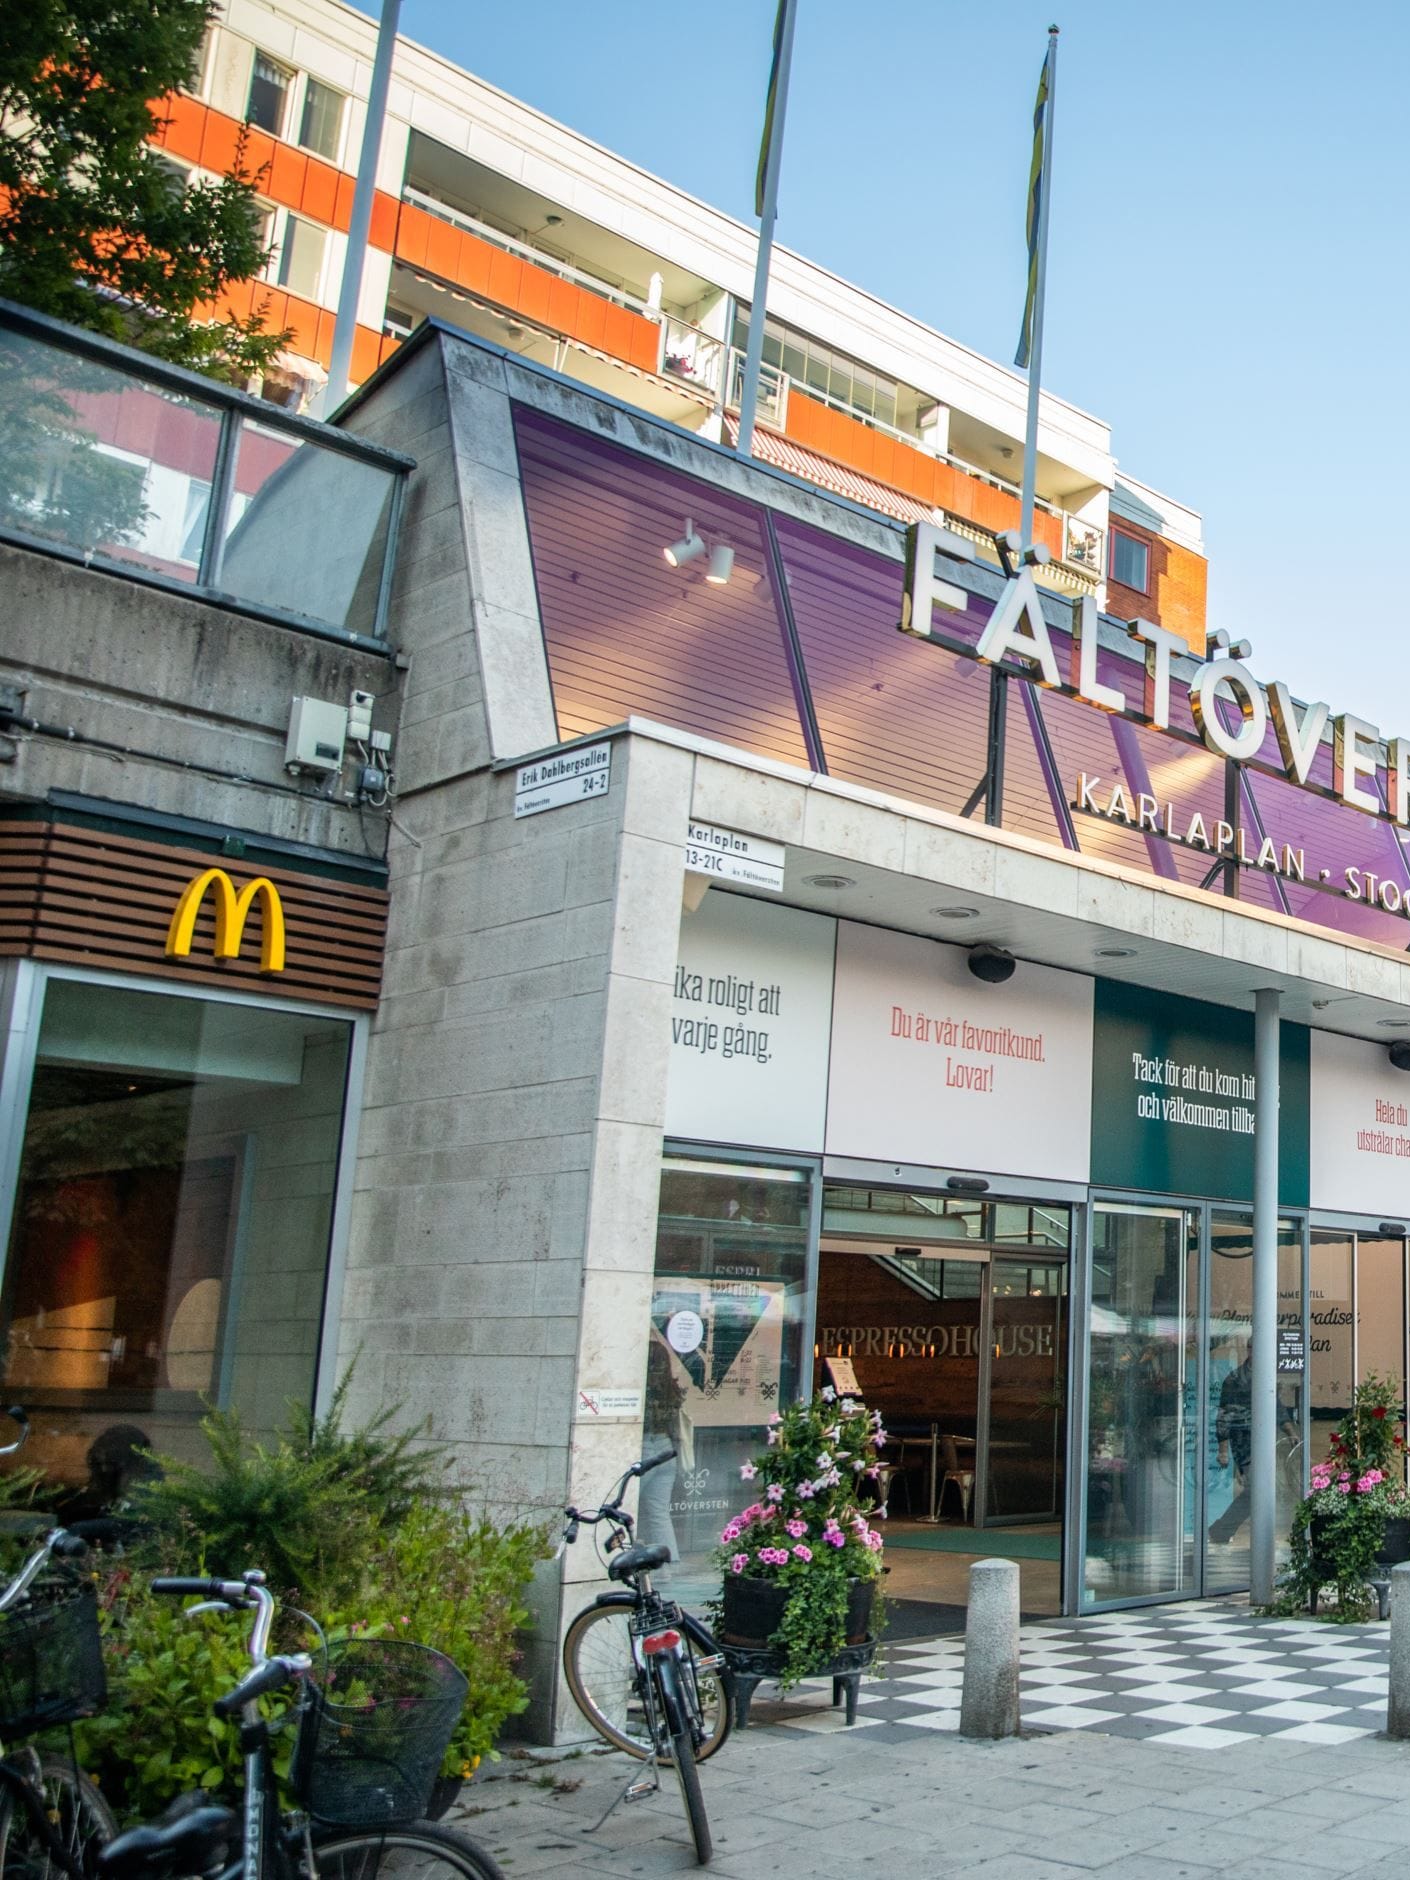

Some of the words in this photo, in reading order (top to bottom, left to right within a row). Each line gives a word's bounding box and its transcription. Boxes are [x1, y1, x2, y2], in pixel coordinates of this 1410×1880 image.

[521, 767, 538, 787] Erik
[541, 750, 608, 780] Dahlbergsallén
[582, 774, 606, 793] 24-2
[687, 823, 748, 853] Karlaplan
[1075, 772, 1306, 882] KARLAPLAN
[685, 849, 723, 872] 13-21C
[674, 965, 703, 1002] ika
[707, 975, 755, 1016] roligt
[758, 984, 781, 1016] att
[671, 1016, 718, 1054] varje
[722, 1022, 772, 1064] gång.
[890, 1006, 912, 1039] Du
[915, 1012, 933, 1042] är
[934, 1016, 960, 1047] vår
[961, 1019, 1046, 1063] favoritkund.
[945, 1056, 994, 1093] Lovar!
[1132, 1052, 1163, 1084] Tack
[1164, 1058, 1180, 1088] för
[1182, 1064, 1197, 1091] att
[1199, 1066, 1213, 1093] du
[1215, 1068, 1240, 1099] kom
[1137, 1092, 1160, 1120] och
[1162, 1096, 1230, 1131] välkommen
[1231, 1105, 1256, 1135] tillba
[1375, 1098, 1395, 1125] Hela
[1396, 1103, 1408, 1127] du
[1357, 1128, 1394, 1156] utstrålar
[666, 1499, 729, 1513] LTÖVERSTEN
